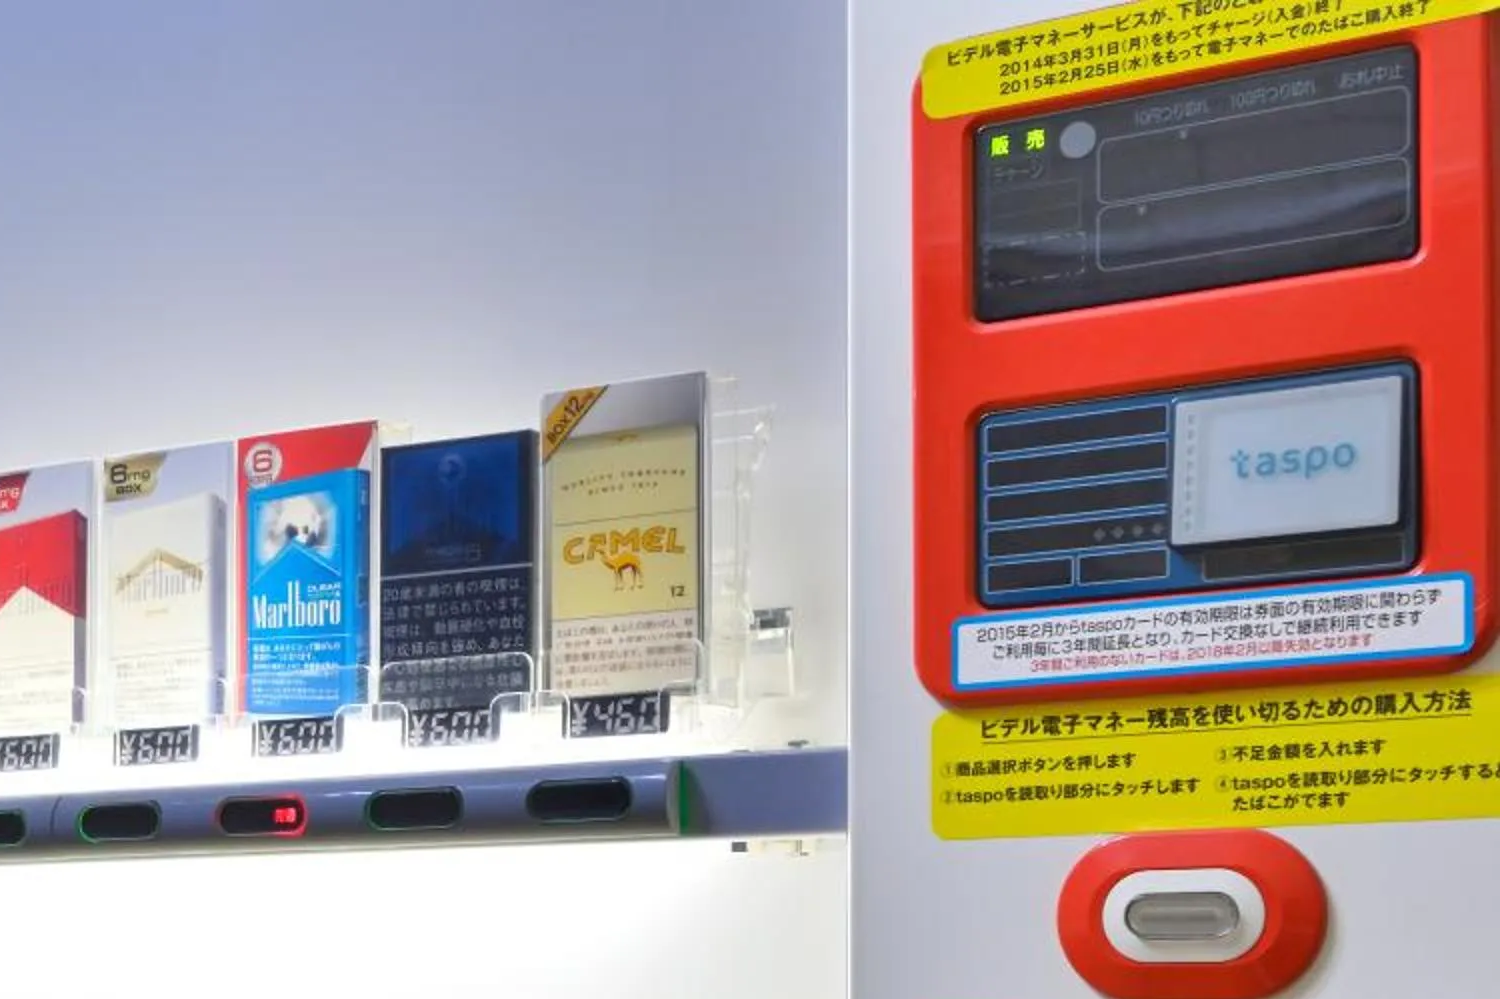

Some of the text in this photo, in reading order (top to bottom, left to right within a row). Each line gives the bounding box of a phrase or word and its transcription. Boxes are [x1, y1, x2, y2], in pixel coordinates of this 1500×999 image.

[1231, 439, 1357, 481] taspo
[562, 524, 687, 565] CAMEL
[252, 580, 341, 631] Marlboro
[669, 583, 686, 598] 12
[410, 711, 492, 748] ¥600
[571, 696, 661, 738] ¥460
